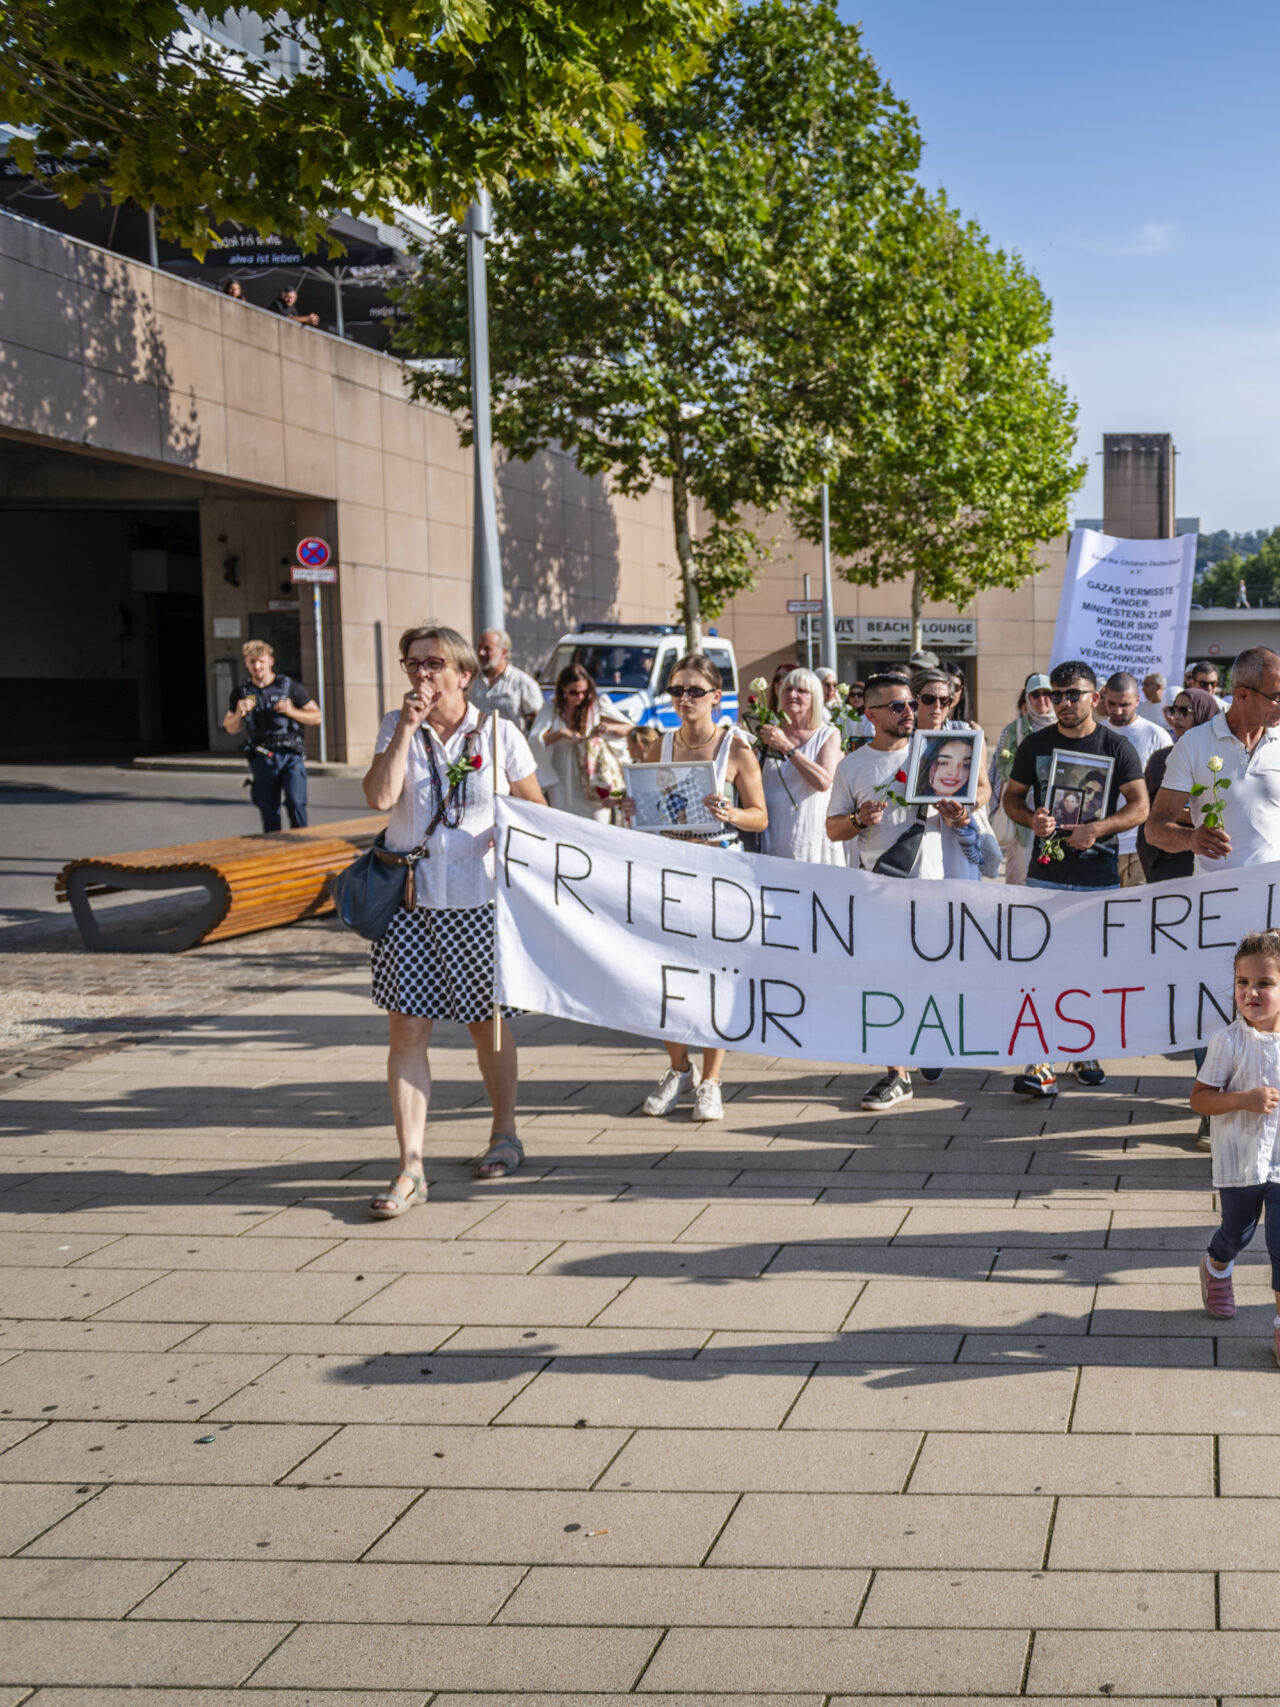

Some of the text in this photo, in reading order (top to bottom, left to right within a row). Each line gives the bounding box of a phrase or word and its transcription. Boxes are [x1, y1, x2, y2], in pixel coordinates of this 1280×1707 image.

[256, 252, 270, 264] ist
[1087, 580, 1174, 596] GAZAS VERMISSTE
[1111, 596, 1151, 608] KINDER:
[1082, 601, 1146, 619] MINDESTENS
[867, 622, 909, 632] BEACH
[922, 623, 973, 634] LOUNGE
[1096, 616, 1159, 630] KINDER SIND
[1099, 628, 1154, 641] VERLOREN
[1092, 660, 1150, 674] INHAFTIERT
[504, 825, 855, 957] FRIEDEN
[909, 900, 1051, 962] UND
[660, 965, 1236, 1056] FÜR PALÄSTIN
